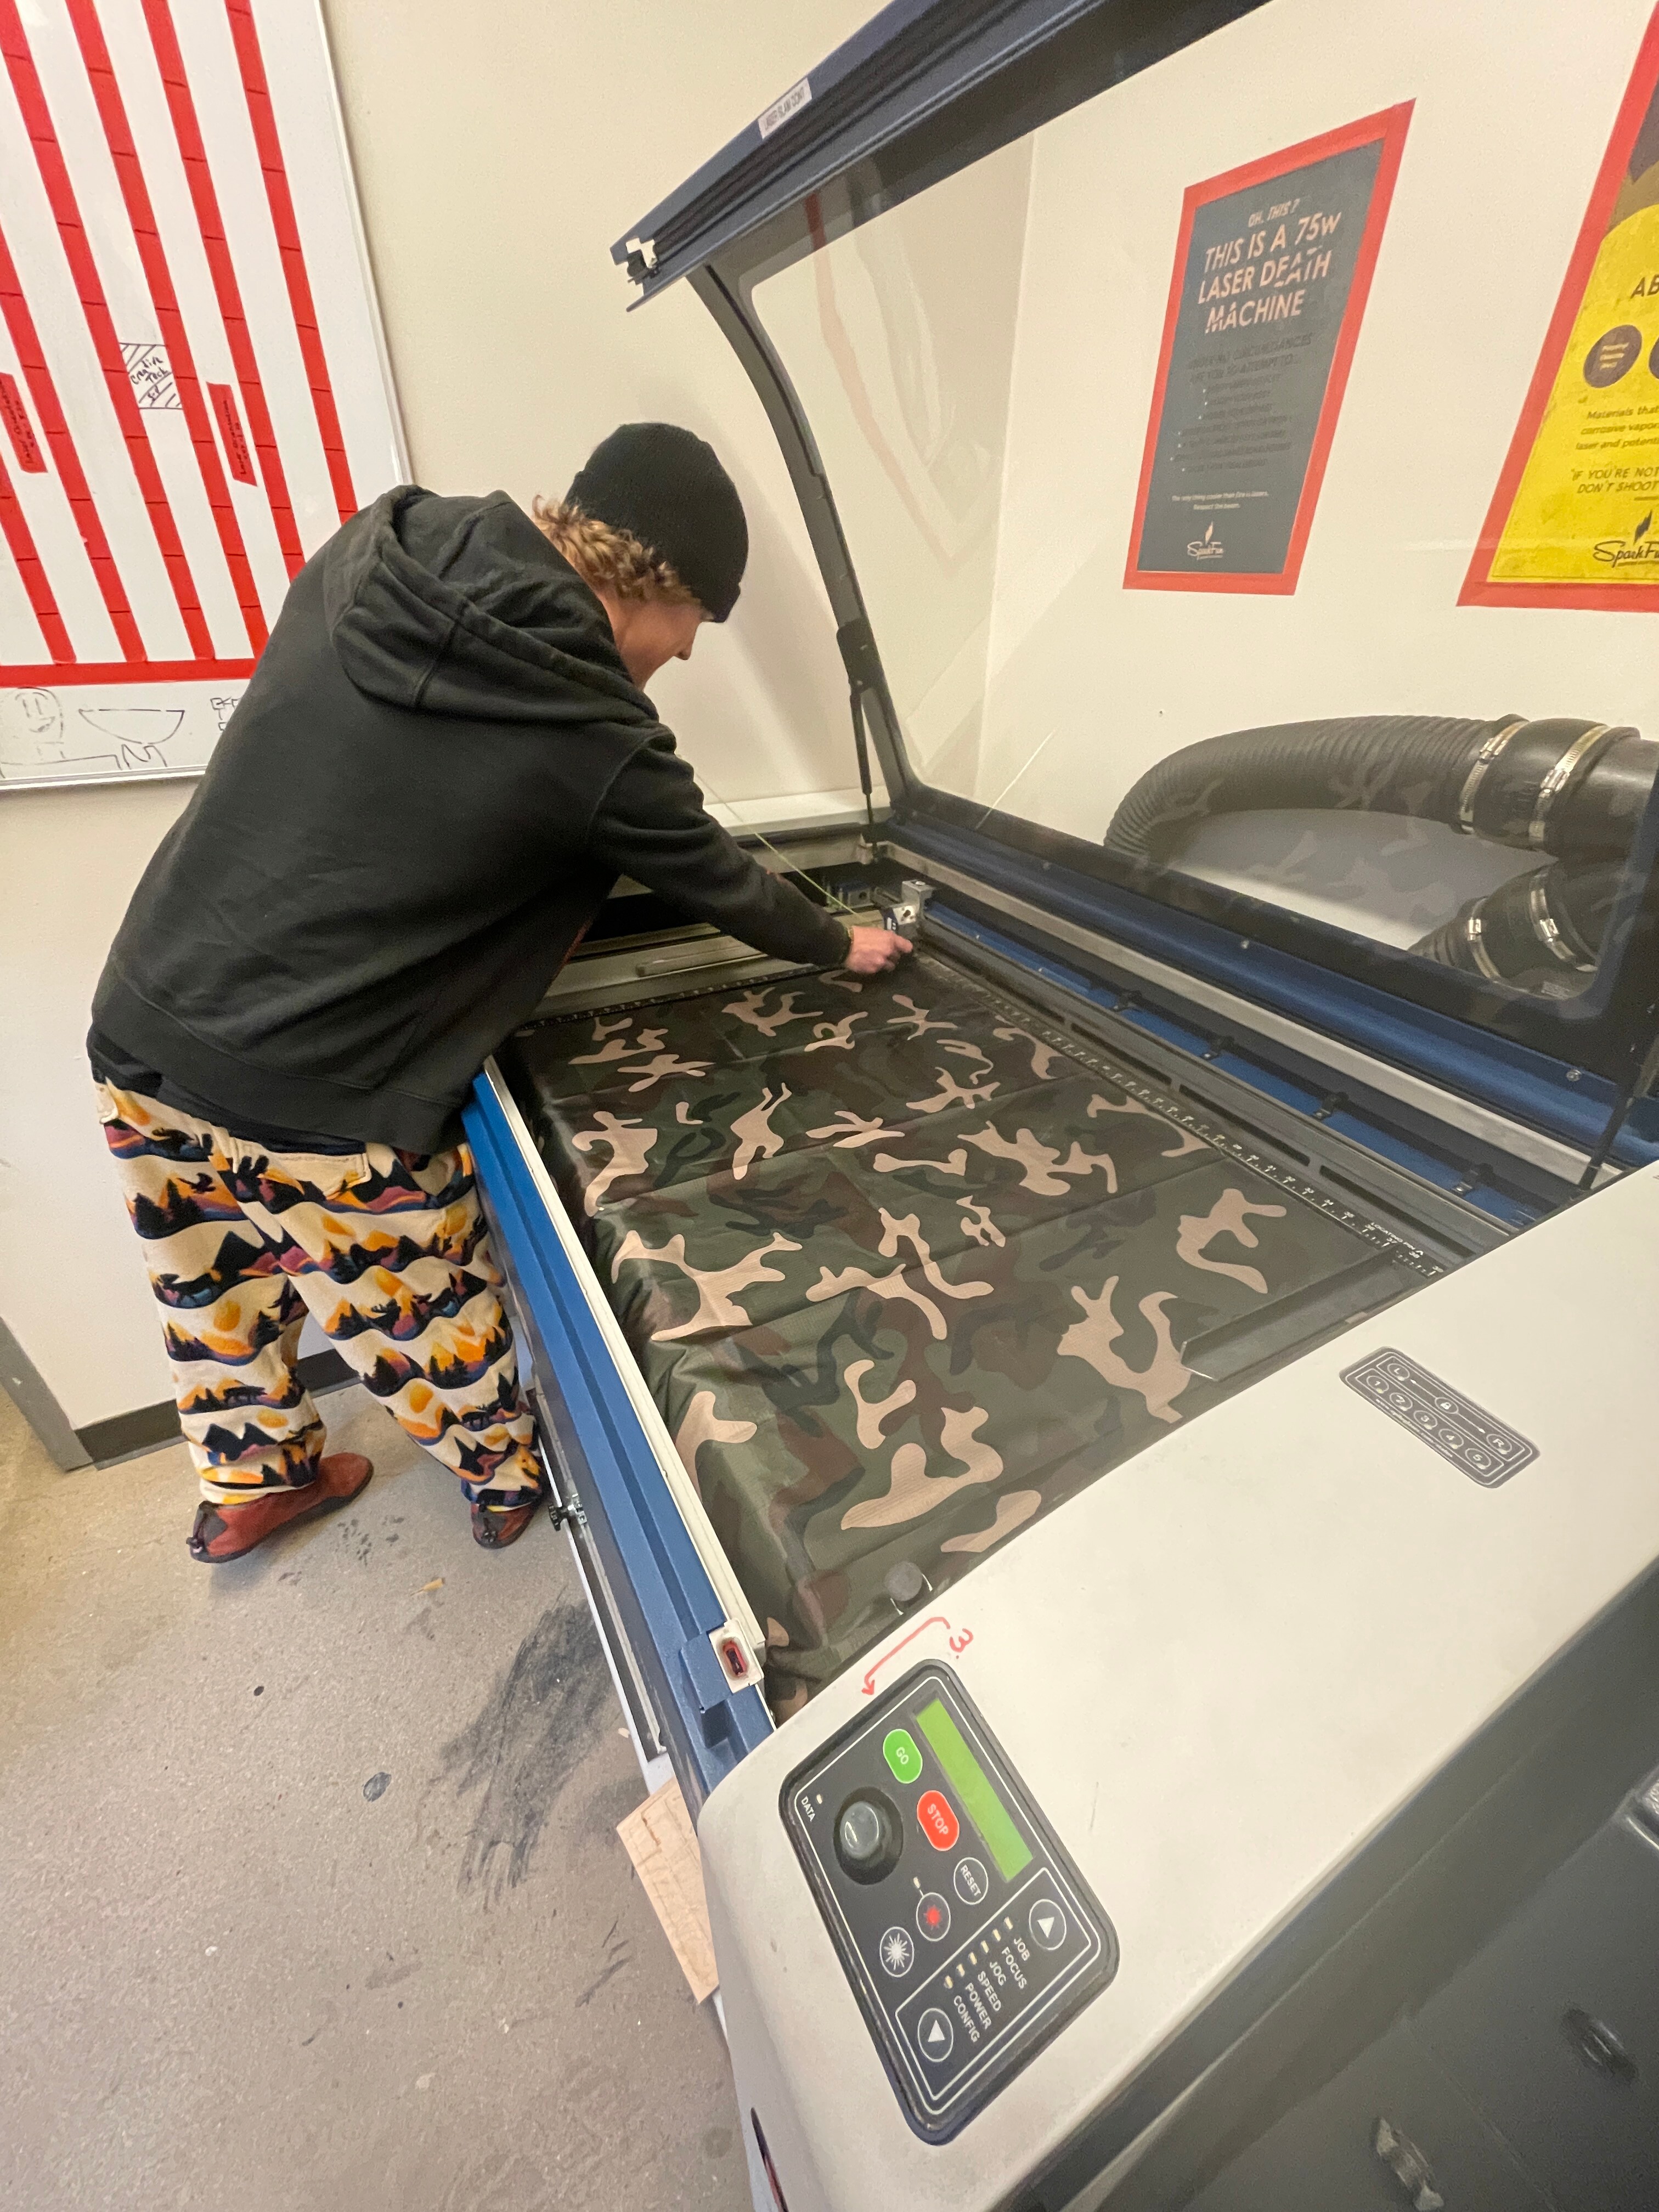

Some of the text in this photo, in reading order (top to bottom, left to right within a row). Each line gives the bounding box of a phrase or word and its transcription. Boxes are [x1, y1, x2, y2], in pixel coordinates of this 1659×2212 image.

[1204, 238, 1245, 273] THIS
[1247, 230, 1266, 260] IS
[1269, 224, 1286, 252] A
[1198, 245, 1333, 304] LASER DEATH
[1205, 289, 1306, 334] MACHINE
[1587, 407, 1634, 419] Materials
[1601, 439, 1622, 449] and
[1589, 465, 1630, 479] YOU'RE
[1577, 480, 1615, 493] DON'T
[1396, 1395, 1405, 1404] 2
[1493, 1438, 1504, 1447] R
[896, 1746, 910, 1765] GO
[801, 1796, 816, 1822] DATA
[927, 1803, 949, 1835] STOP
[961, 1864, 981, 1897] RESET
[1013, 1937, 1030, 1961] JOB
[989, 1961, 1007, 1986] JOG
[1001, 1946, 1028, 1989] FOCUS
[977, 1971, 1002, 2012] SPEED
[953, 1995, 980, 2042] CONFIG
[964, 1982, 992, 2030] POWER
